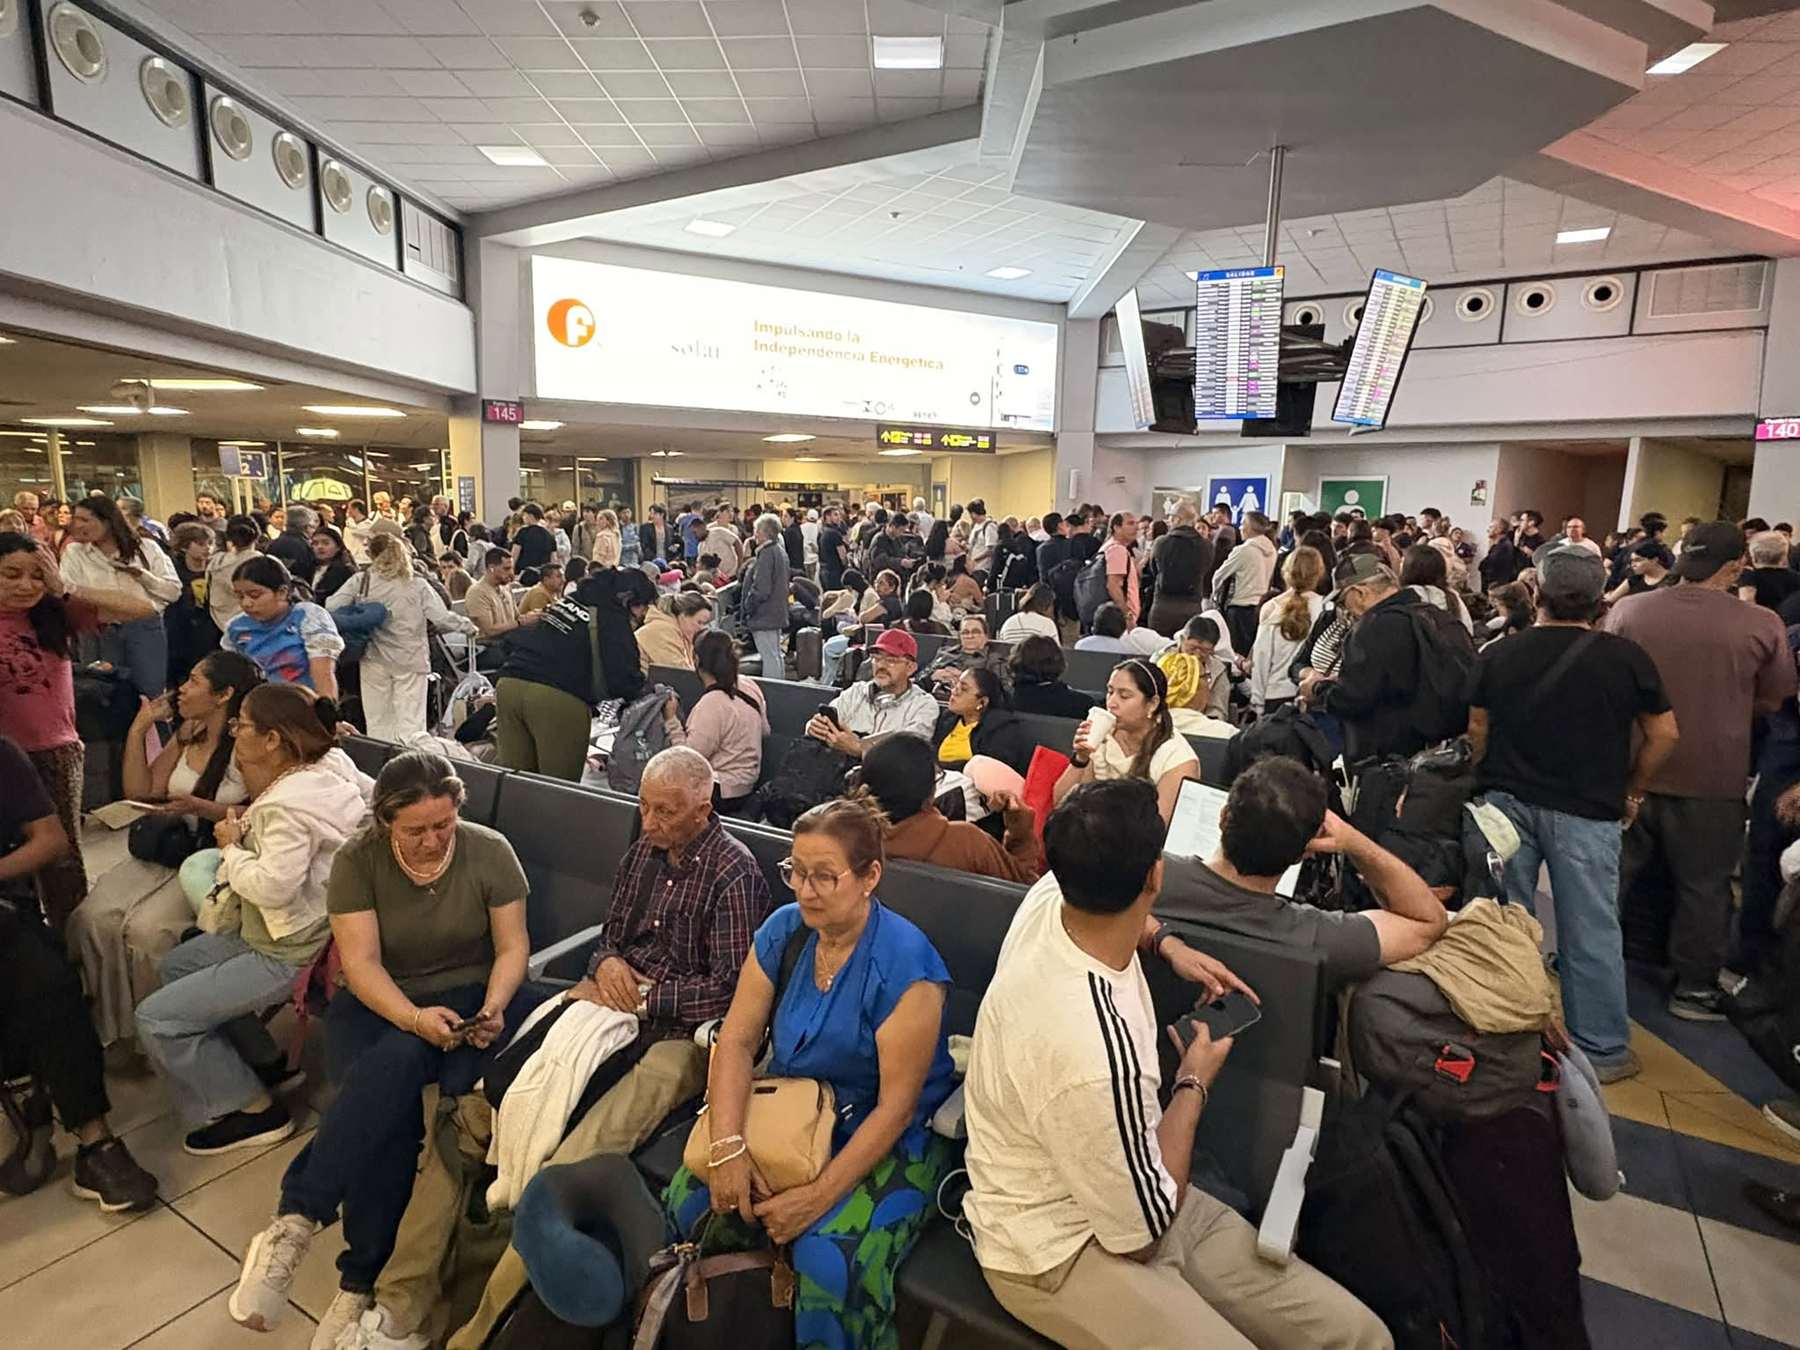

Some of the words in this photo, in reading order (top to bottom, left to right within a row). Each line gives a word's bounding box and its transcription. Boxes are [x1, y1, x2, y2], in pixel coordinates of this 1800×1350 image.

[754, 319, 842, 341] Impulsando
[754, 339, 865, 362] Independencia
[494, 407, 517, 421] 145
[1766, 423, 1798, 438] 140
